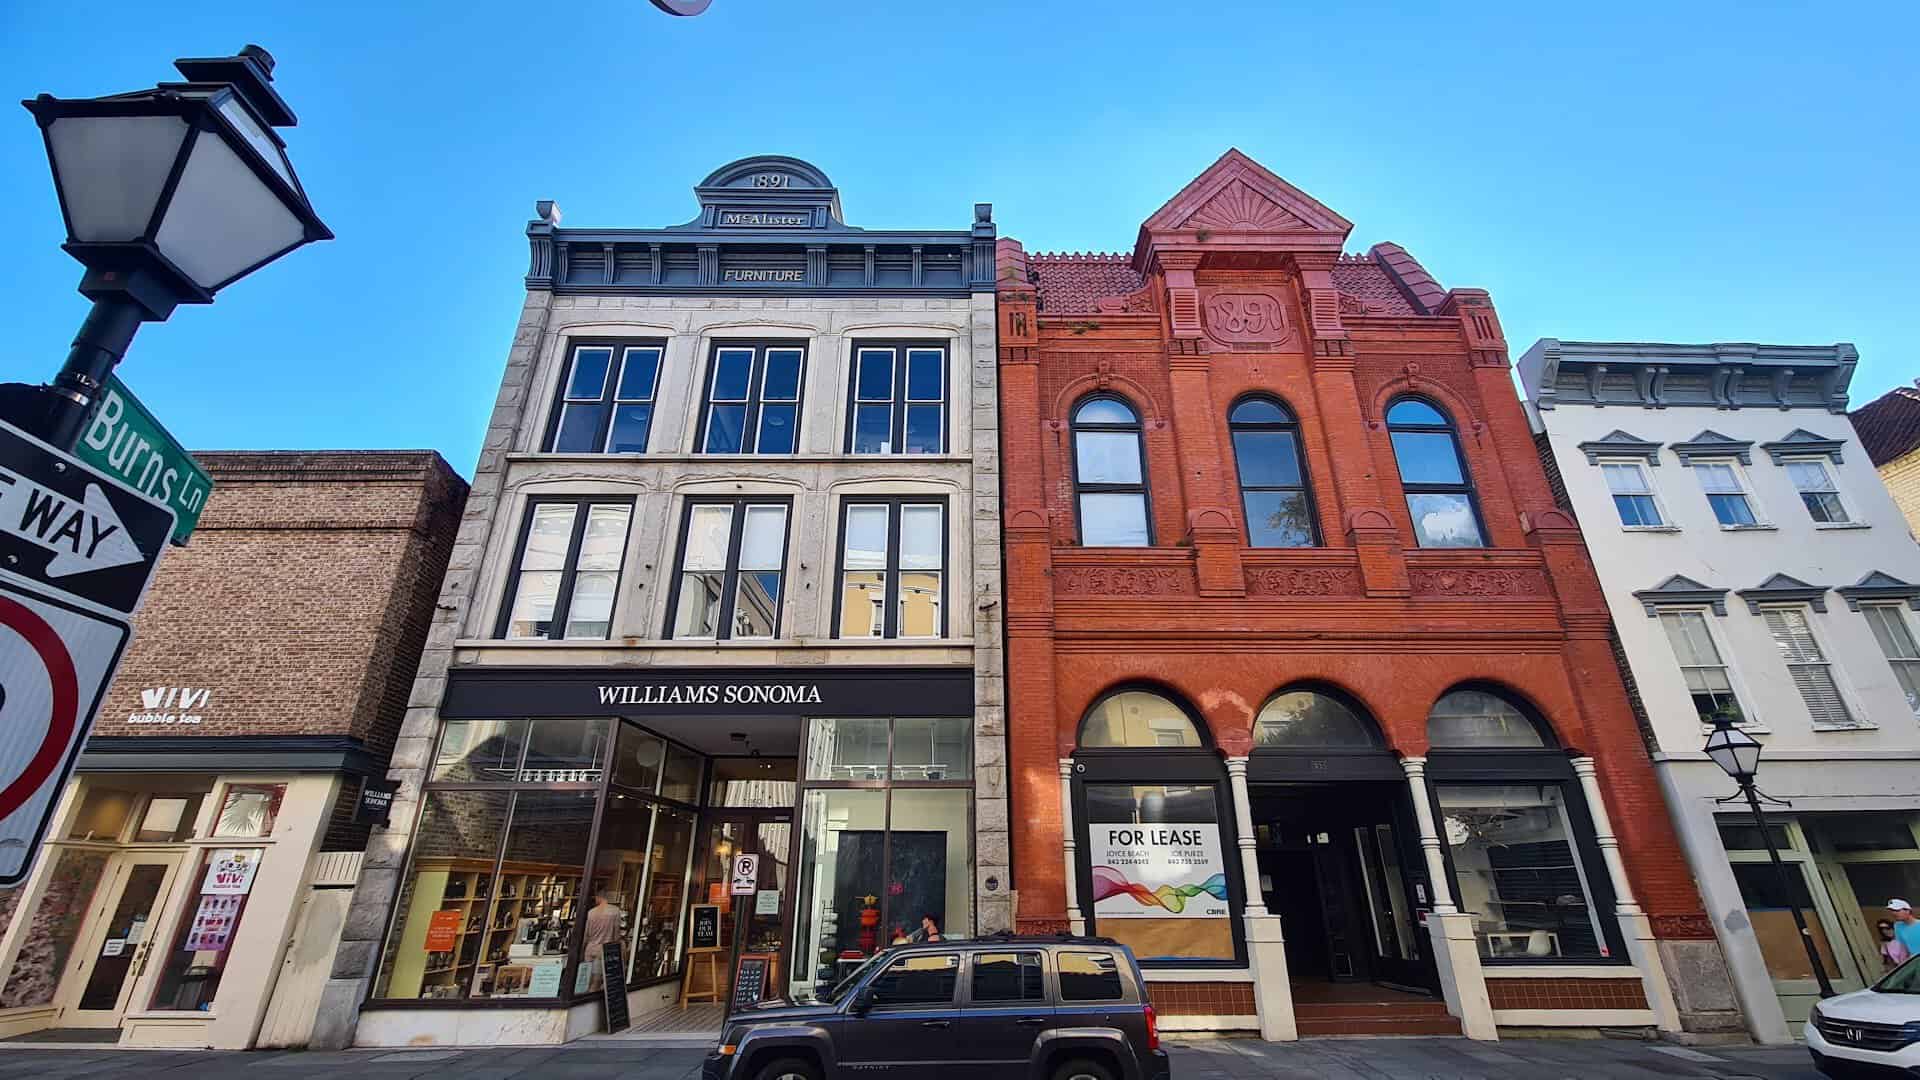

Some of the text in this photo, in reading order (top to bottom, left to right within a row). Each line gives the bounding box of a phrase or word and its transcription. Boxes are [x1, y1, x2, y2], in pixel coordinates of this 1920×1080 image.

[751, 175, 790, 188] 1891
[724, 269, 803, 281] FURNITURE
[1207, 299, 1281, 334] 1891
[84, 389, 202, 513] Burns Ln
[19, 488, 119, 559] WAY
[598, 685, 822, 704] WILLIAMS SONOMA
[128, 712, 201, 724] bubble tea
[1108, 830, 1203, 846] FOR LEASE
